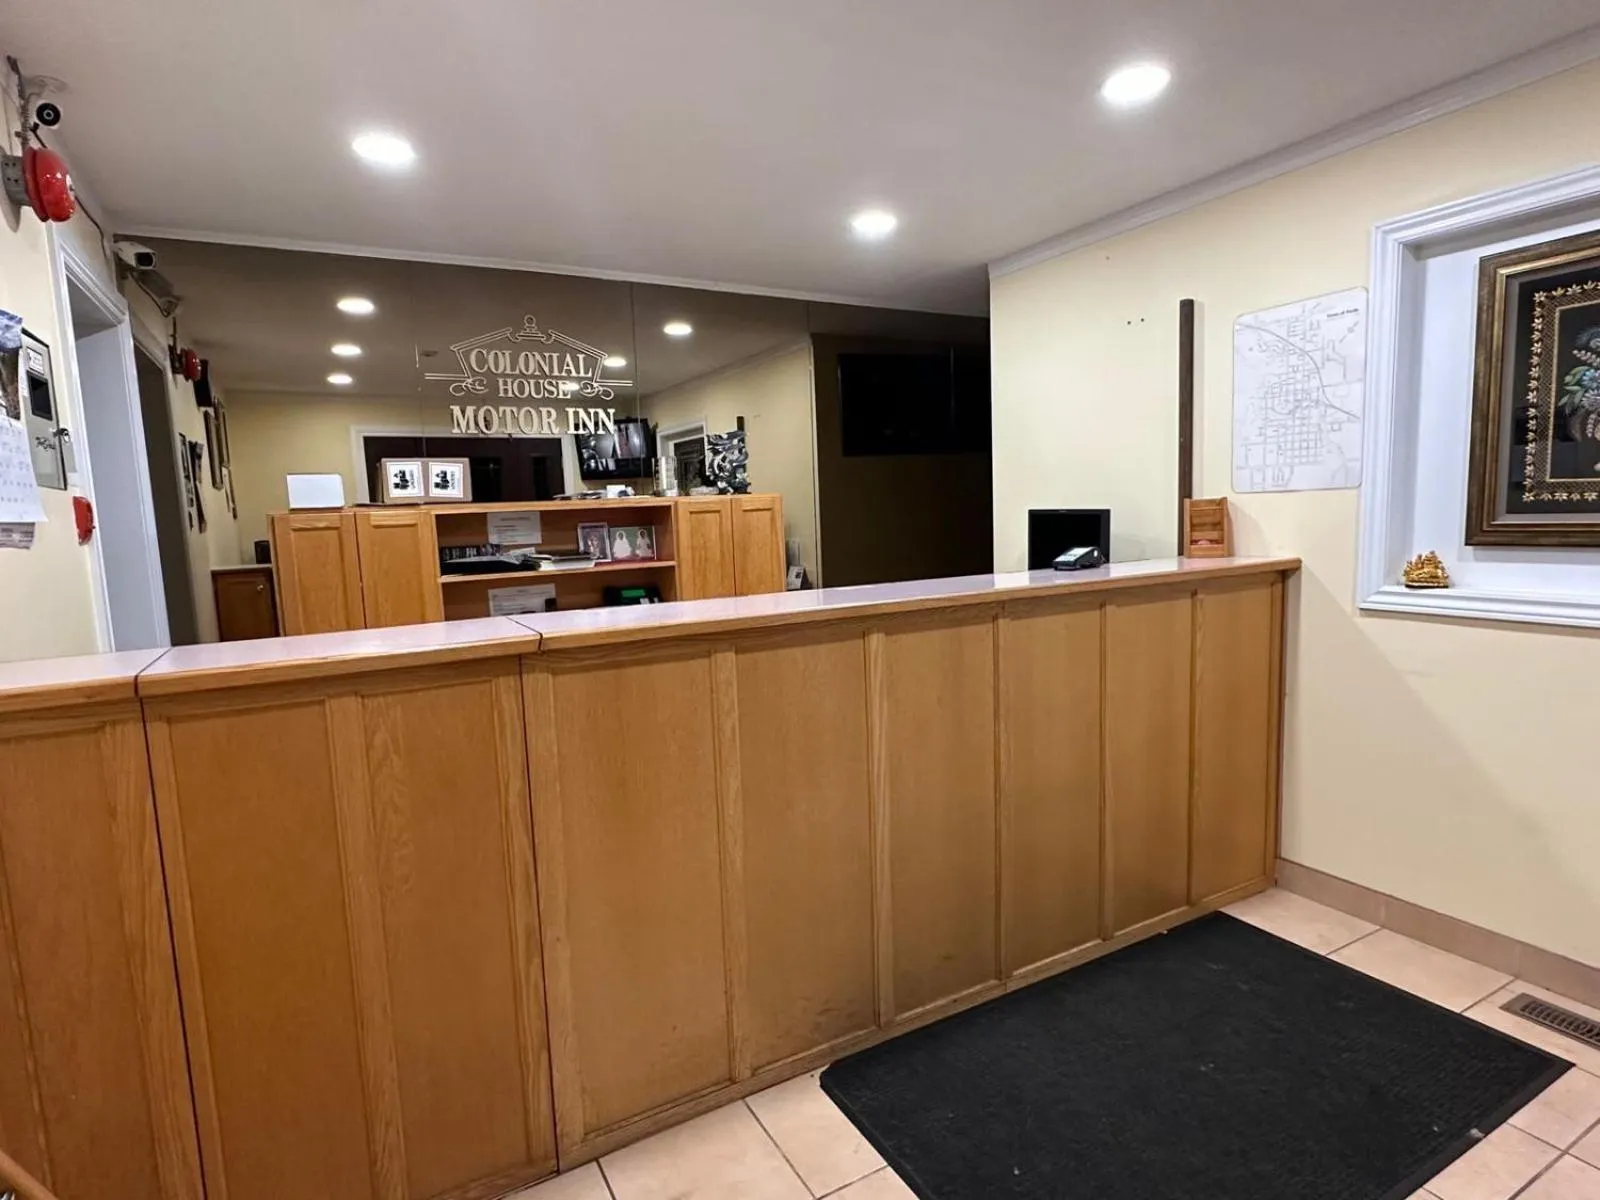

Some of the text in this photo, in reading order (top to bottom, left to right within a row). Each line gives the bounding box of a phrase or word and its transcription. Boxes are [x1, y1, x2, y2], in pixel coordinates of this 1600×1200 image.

[469, 349, 592, 377] COLONIAL
[497, 378, 572, 399] HOUSE
[450, 405, 615, 435] MOTOR INN
